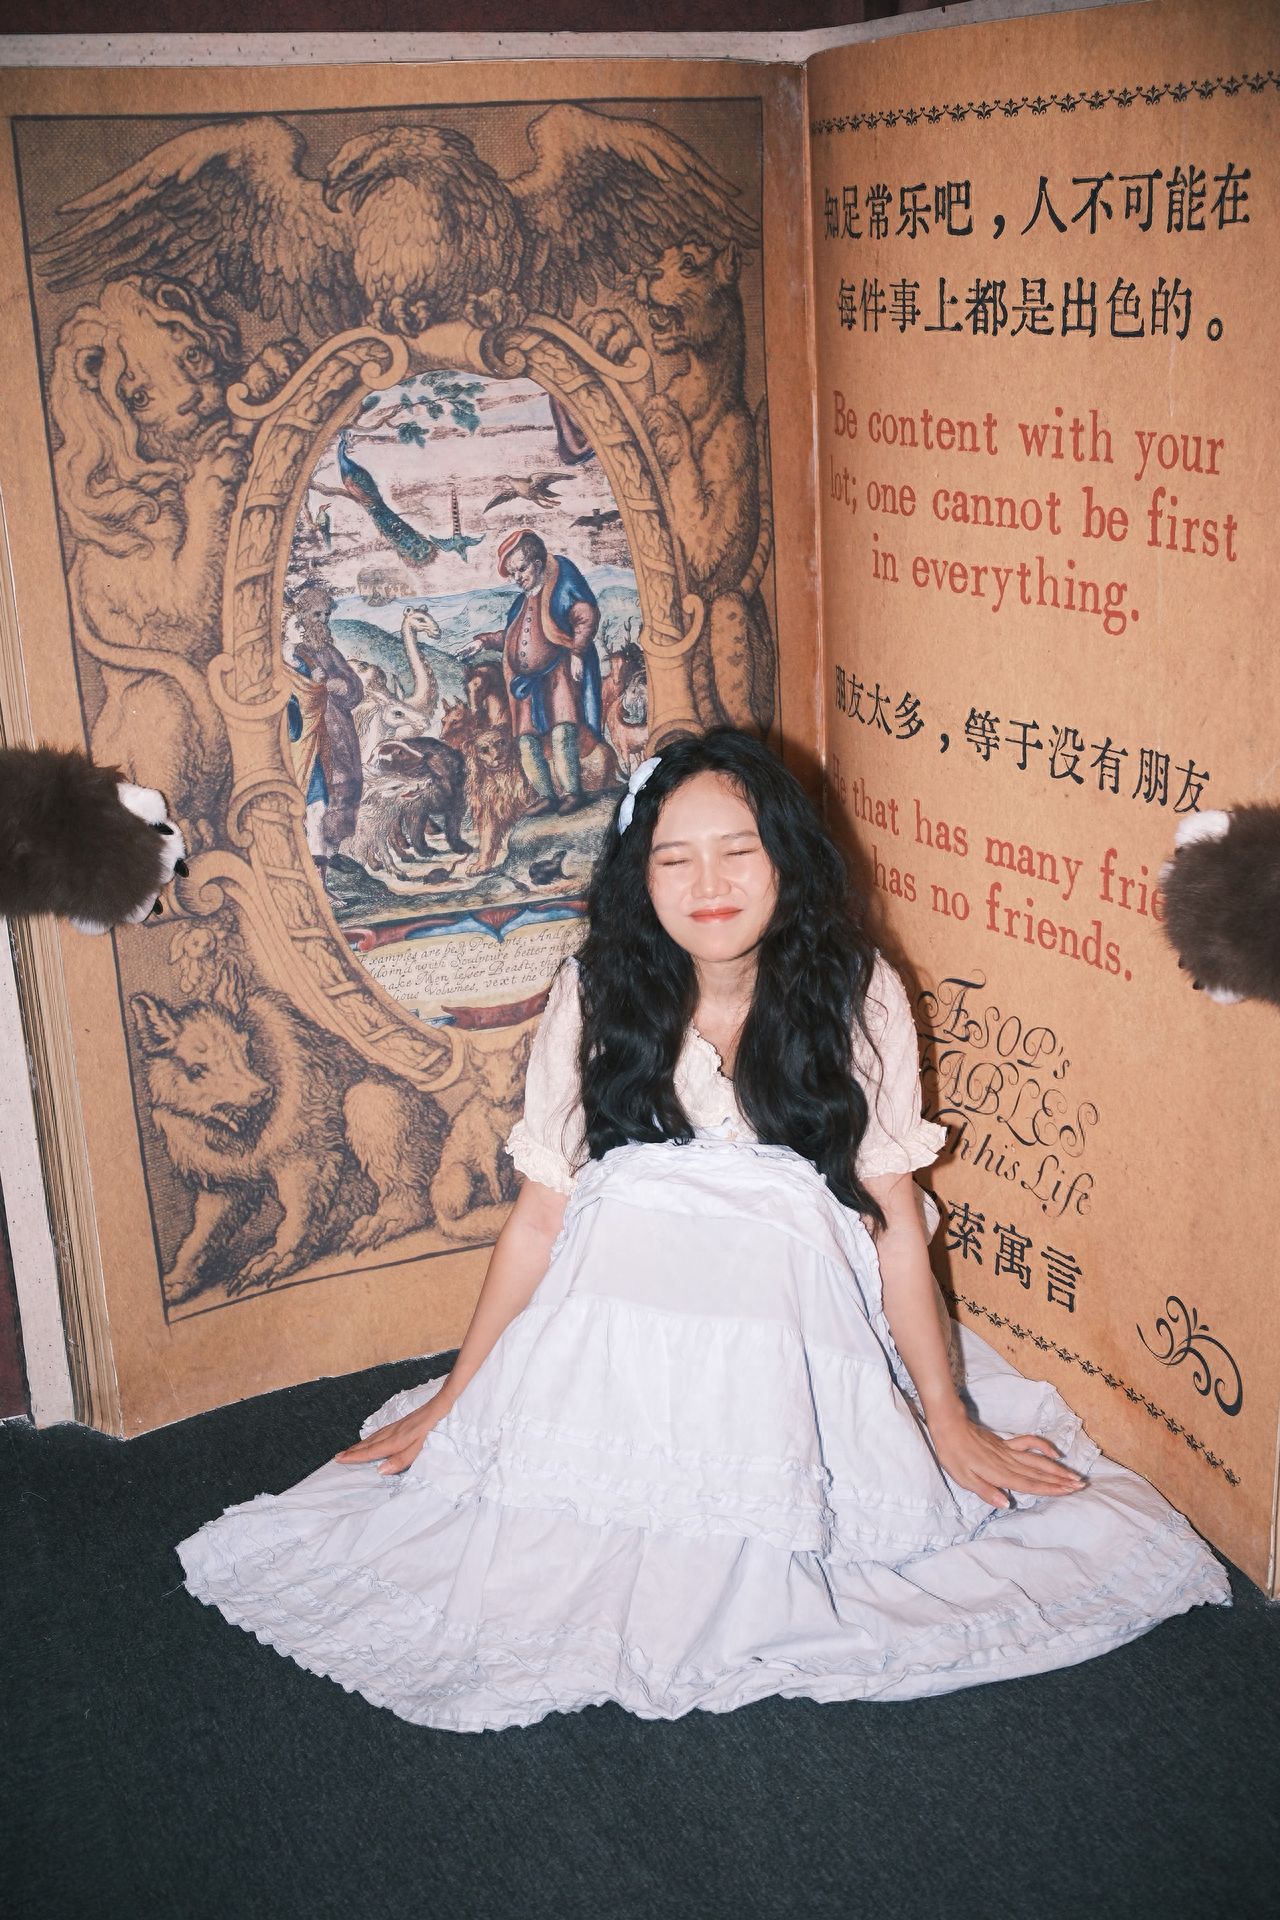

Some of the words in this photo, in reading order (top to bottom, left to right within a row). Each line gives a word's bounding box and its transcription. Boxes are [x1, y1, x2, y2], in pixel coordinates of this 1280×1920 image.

[823, 162, 1252, 241] 知足常乐吧，人不可能在
[837, 276, 1225, 342] 每件事上都是出色的。
[833, 389, 858, 440] Be
[868, 408, 998, 456] content
[1018, 406, 1114, 464] with
[1134, 428, 1225, 482] your
[830, 455, 858, 515] lot;
[866, 476, 917, 518] one
[932, 486, 1062, 536] cannot
[1081, 485, 1129, 542] be
[1147, 486, 1238, 562] first
[872, 532, 899, 583] in
[912, 555, 1140, 636] everything.
[834, 664, 1210, 814] 朋友太多，等于没有朋友
[832, 753, 847, 805] He
[852, 777, 900, 837] that
[913, 798, 969, 857] has
[985, 835, 1083, 901] many
[1099, 847, 1167, 923] frie
[872, 845, 917, 902] has
[931, 881, 970, 921] no
[985, 881, 1133, 982] friends.
[973, 1134, 1020, 1181] his
[1020, 1154, 1094, 1218] Life
[931, 1193, 1083, 1313] 索寓言
